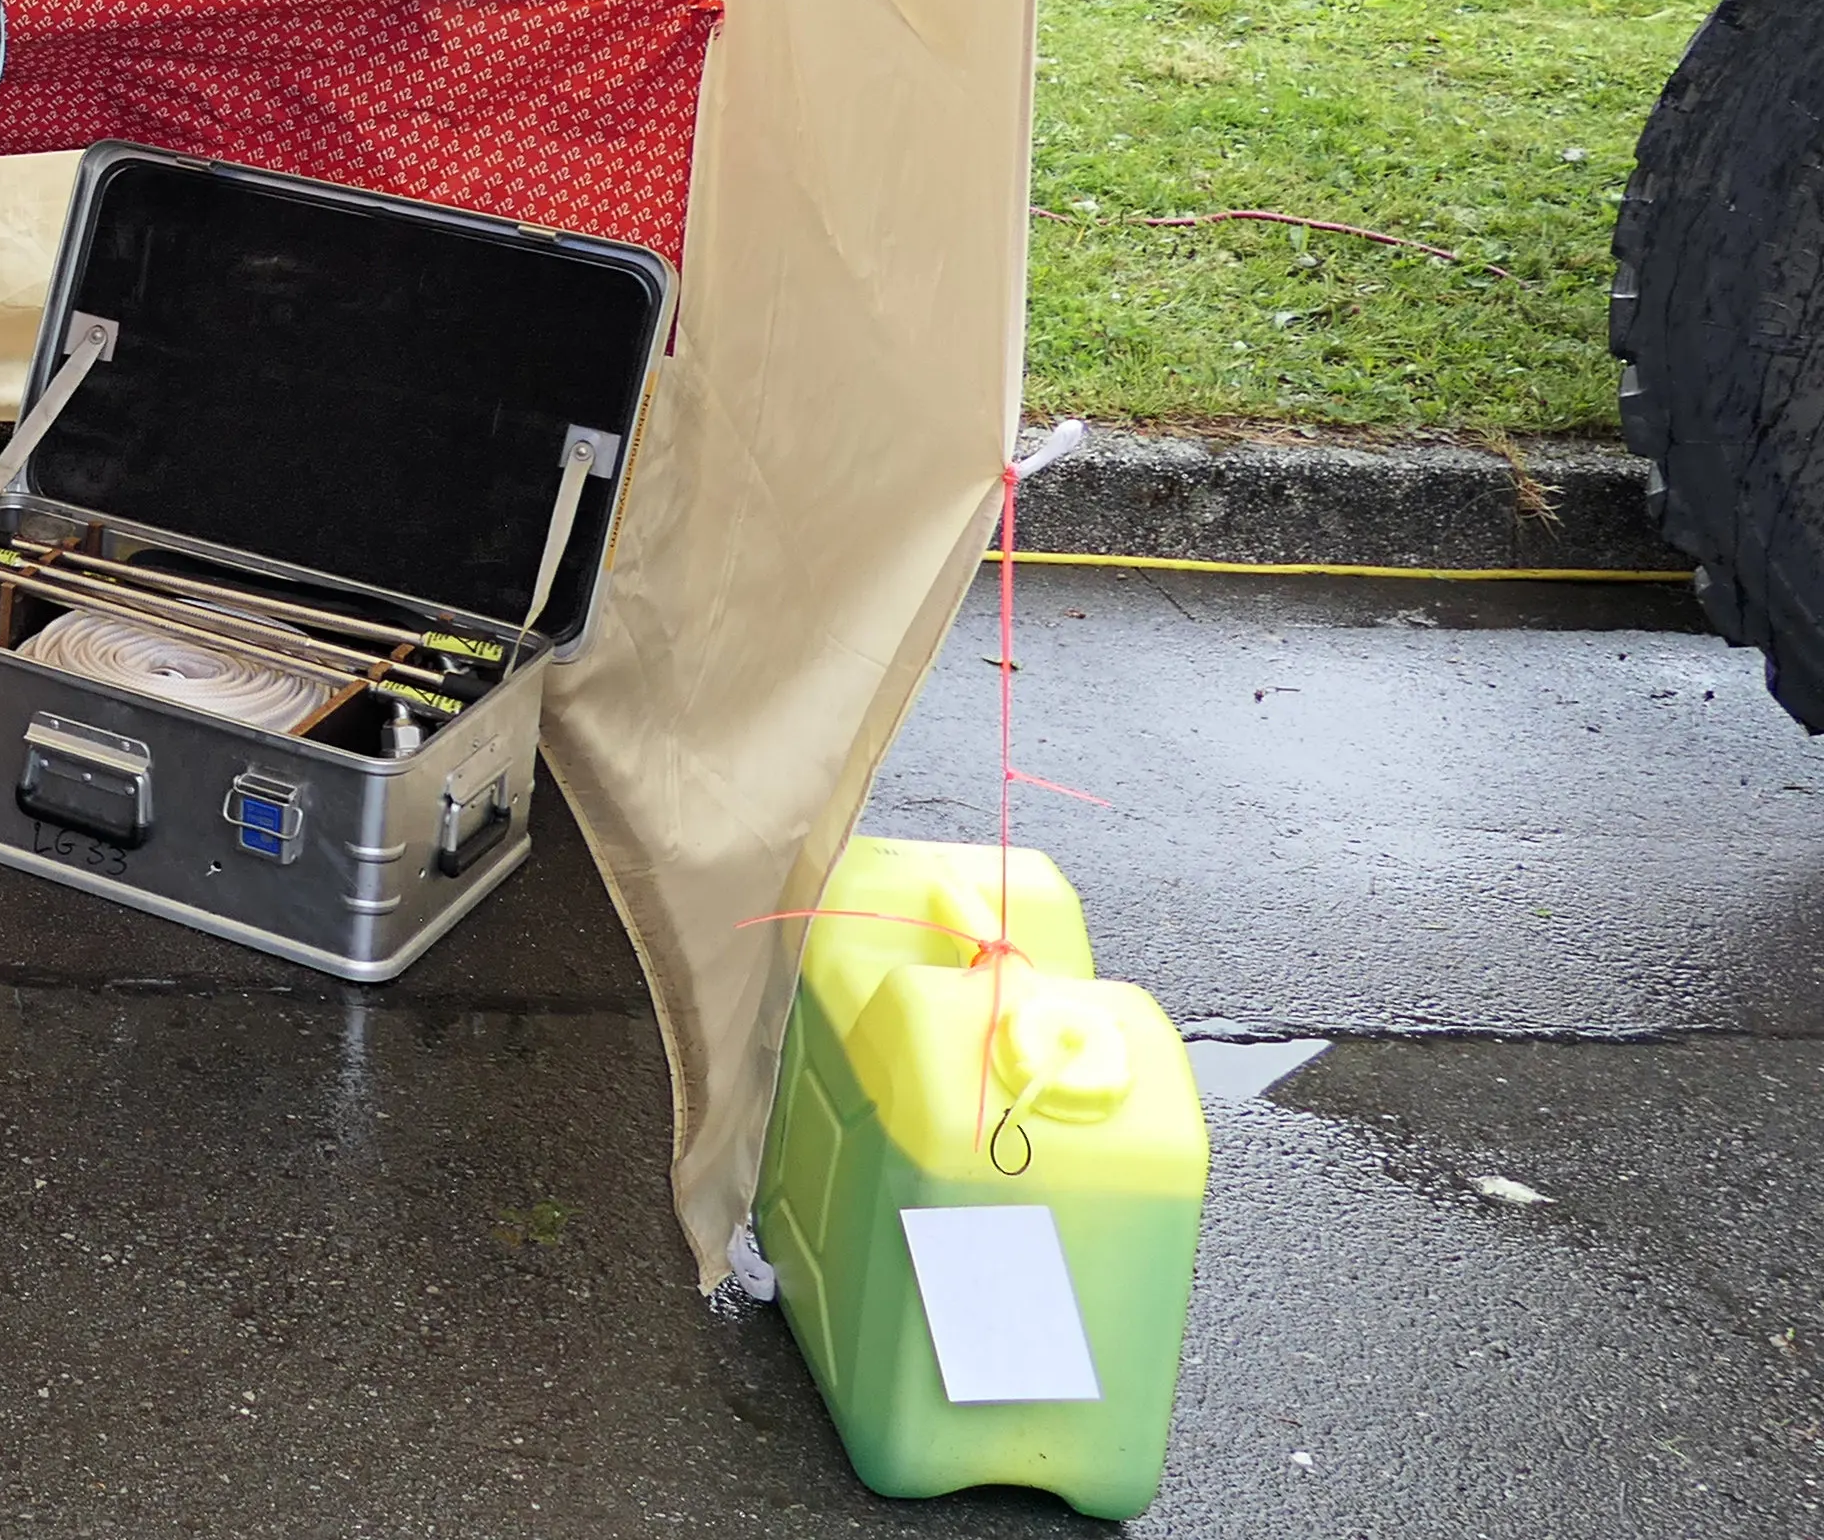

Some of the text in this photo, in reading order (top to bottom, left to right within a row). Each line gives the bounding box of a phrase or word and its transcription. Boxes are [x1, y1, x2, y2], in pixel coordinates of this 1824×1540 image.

[86, 0, 105, 16] 112
[130, 2, 150, 19] 112
[152, 3, 172, 19] 112
[34, 16, 54, 31] 112
[282, 17, 302, 33] 112
[217, 28, 236, 43] 112
[261, 33, 280, 48] 112
[370, 31, 389, 47] 112
[421, 29, 440, 45] 112
[510, 34, 531, 51] 112
[604, 30, 625, 45] 112
[327, 39, 346, 55] 112
[532, 40, 552, 56] 112
[113, 56, 133, 70] 112
[368, 52, 386, 68] 112
[430, 56, 450, 72] 112
[629, 57, 648, 75] 112
[178, 63, 197, 80] 112
[199, 65, 219, 81] 112
[406, 69, 425, 85] 112
[472, 68, 493, 84] 112
[565, 61, 586, 77] 112
[586, 69, 605, 84] 112
[312, 75, 331, 90] 112
[604, 73, 624, 91] 112
[668, 78, 686, 97] 112
[4, 85, 22, 100] 112
[128, 87, 148, 101] 112
[243, 89, 262, 105] 112
[448, 82, 468, 99] 112
[572, 87, 592, 103] 112
[27, 97, 44, 111] 112
[68, 93, 86, 107] 112
[616, 97, 636, 115] 112
[214, 103, 232, 118] 112
[369, 100, 388, 117] 112
[660, 99, 678, 118] 112
[172, 110, 191, 125] 112
[338, 110, 355, 124] 112
[411, 111, 431, 129] 112
[518, 113, 538, 131] 112
[277, 119, 296, 133] 112
[472, 125, 493, 142] 112
[540, 120, 560, 136] 112
[658, 122, 677, 141] 112
[229, 139, 247, 153] 112
[400, 131, 420, 148] 112
[585, 131, 605, 148] 112
[607, 136, 627, 153] 112
[247, 147, 265, 162] 112
[376, 146, 397, 163] 112
[441, 139, 461, 157] 112
[462, 144, 482, 162] 112
[668, 147, 686, 165] 112
[347, 156, 366, 170] 112
[506, 155, 526, 173] 112
[625, 160, 644, 178] 112
[388, 172, 408, 187] 112
[409, 177, 429, 194] 112
[573, 172, 593, 190] 112
[666, 169, 683, 187] 112
[430, 181, 450, 199] 112
[527, 183, 547, 201] 112
[591, 199, 610, 216] 112
[654, 212, 673, 231] 112
[34, 821, 75, 855] LG
